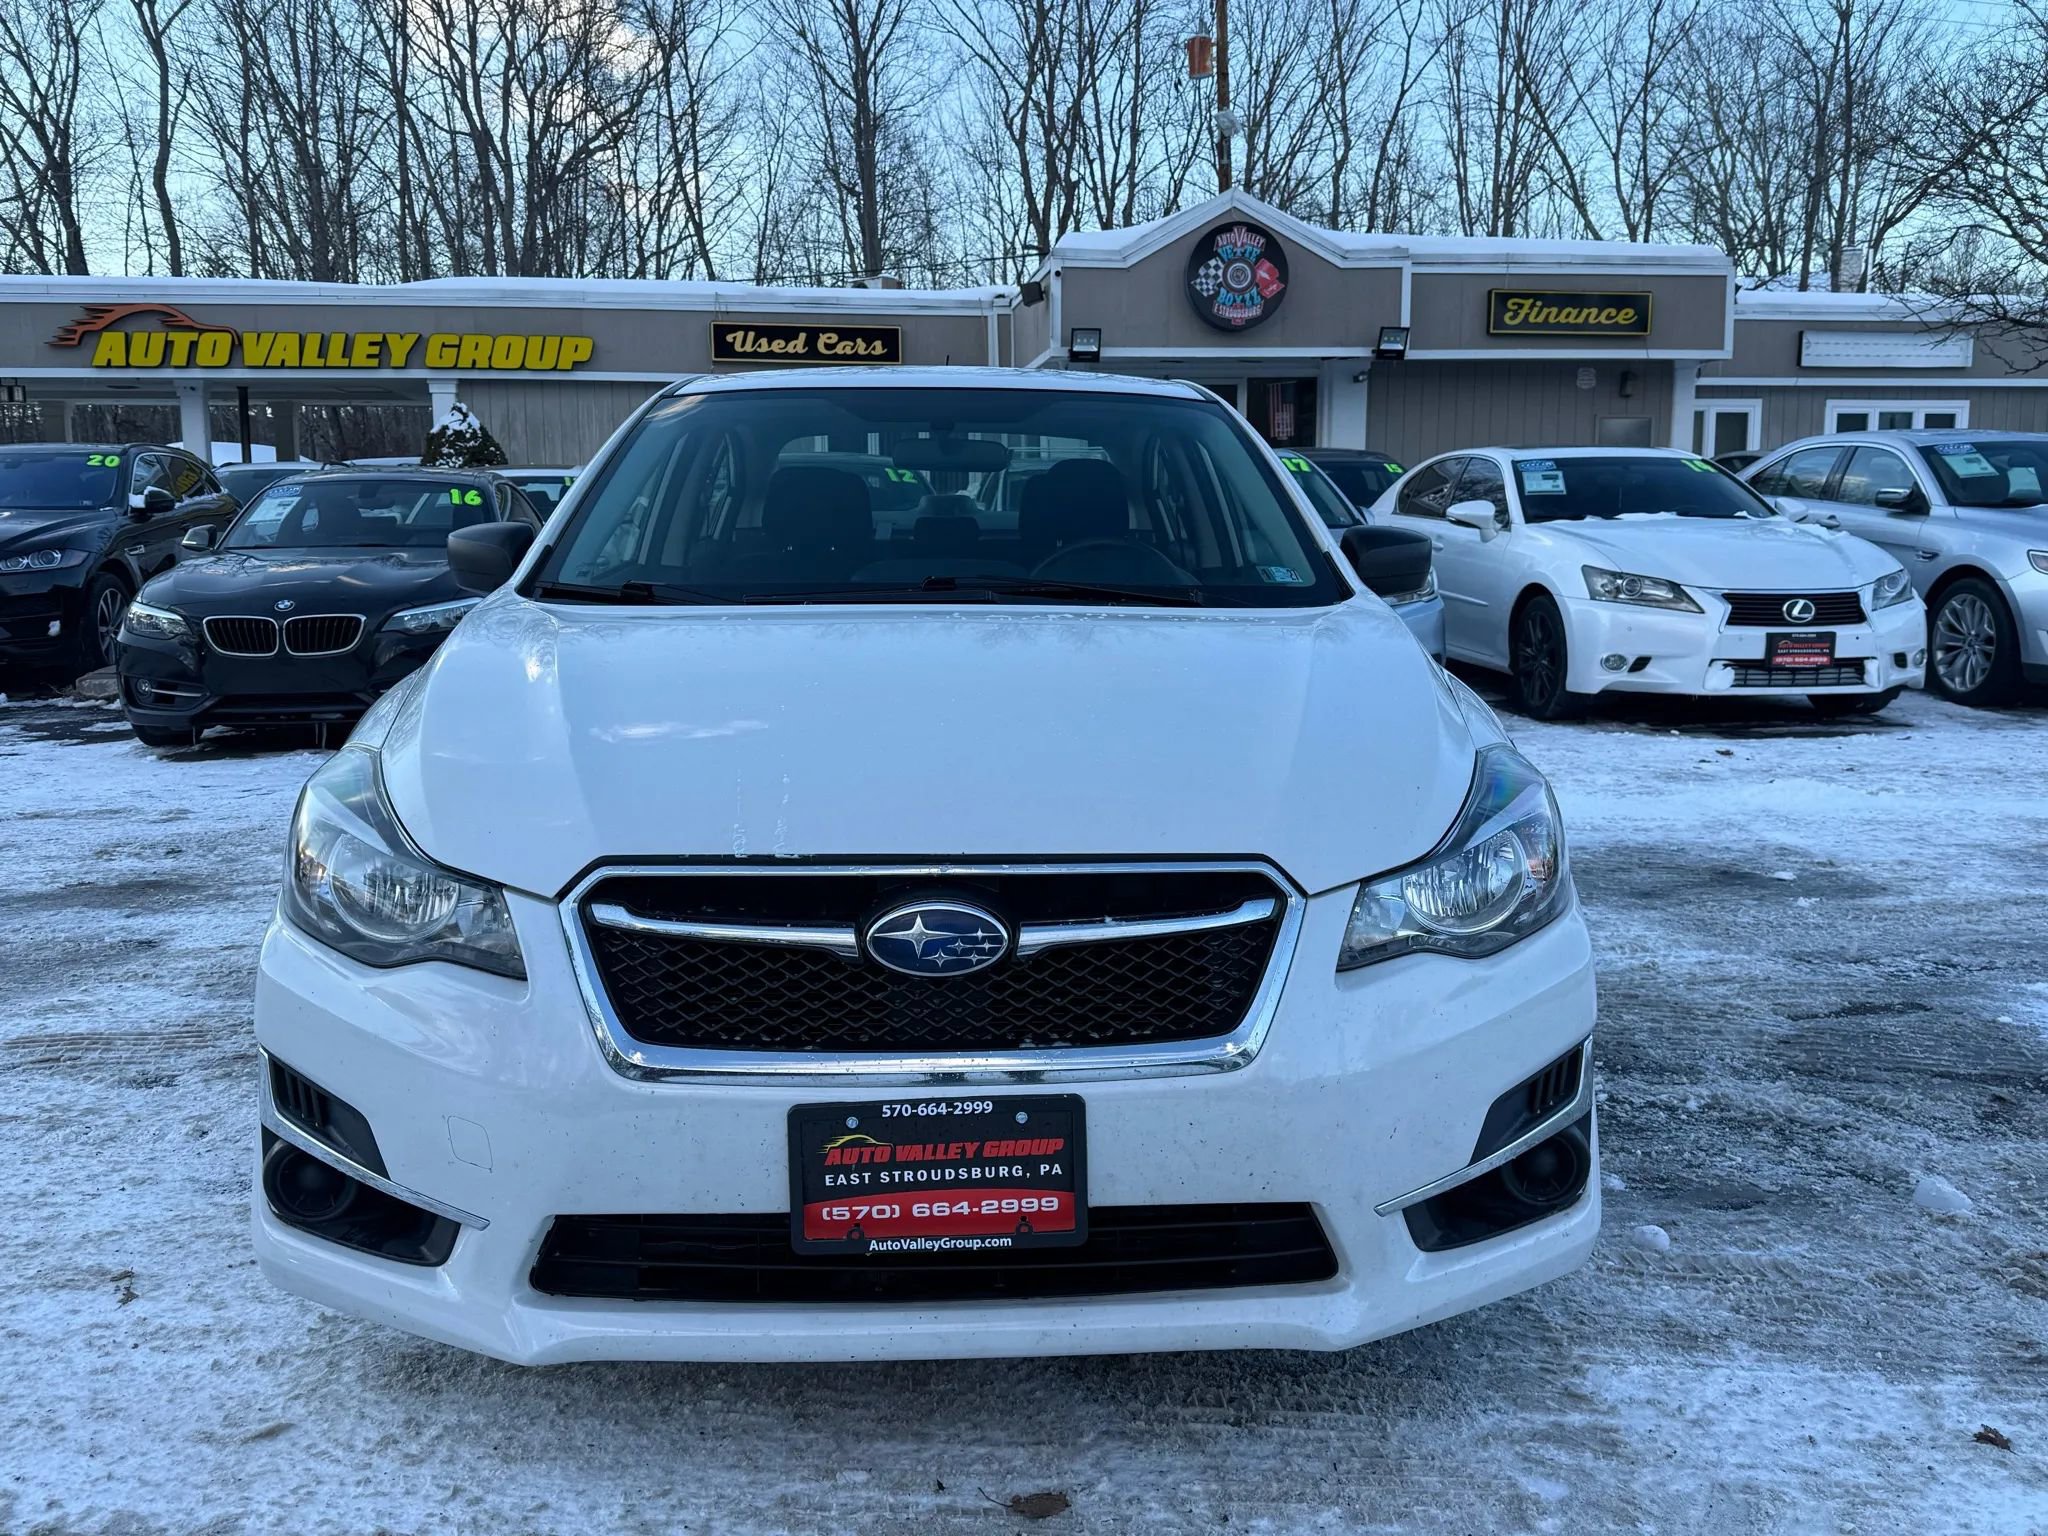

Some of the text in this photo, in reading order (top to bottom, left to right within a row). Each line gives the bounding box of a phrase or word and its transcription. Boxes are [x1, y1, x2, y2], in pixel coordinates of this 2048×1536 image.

[1503, 298, 1638, 326] Finance
[91, 331, 595, 371] AUTO VALLEY GROUP
[725, 330, 888, 356] Used Cars
[86, 454, 121, 468] 20
[1281, 457, 1312, 473] 17
[1383, 463, 1405, 474] 15
[884, 467, 918, 484] 12
[450, 488, 482, 506] 16
[881, 1101, 993, 1118] 570-664-2999
[824, 1138, 1065, 1166] AUTO VALLEY GROUP
[824, 1163, 1064, 1187] EAST STROUDSBURG, PA
[821, 1196, 1060, 1221] (570) 664-2999
[869, 1235, 1013, 1253] AutoValleyGroup.com
